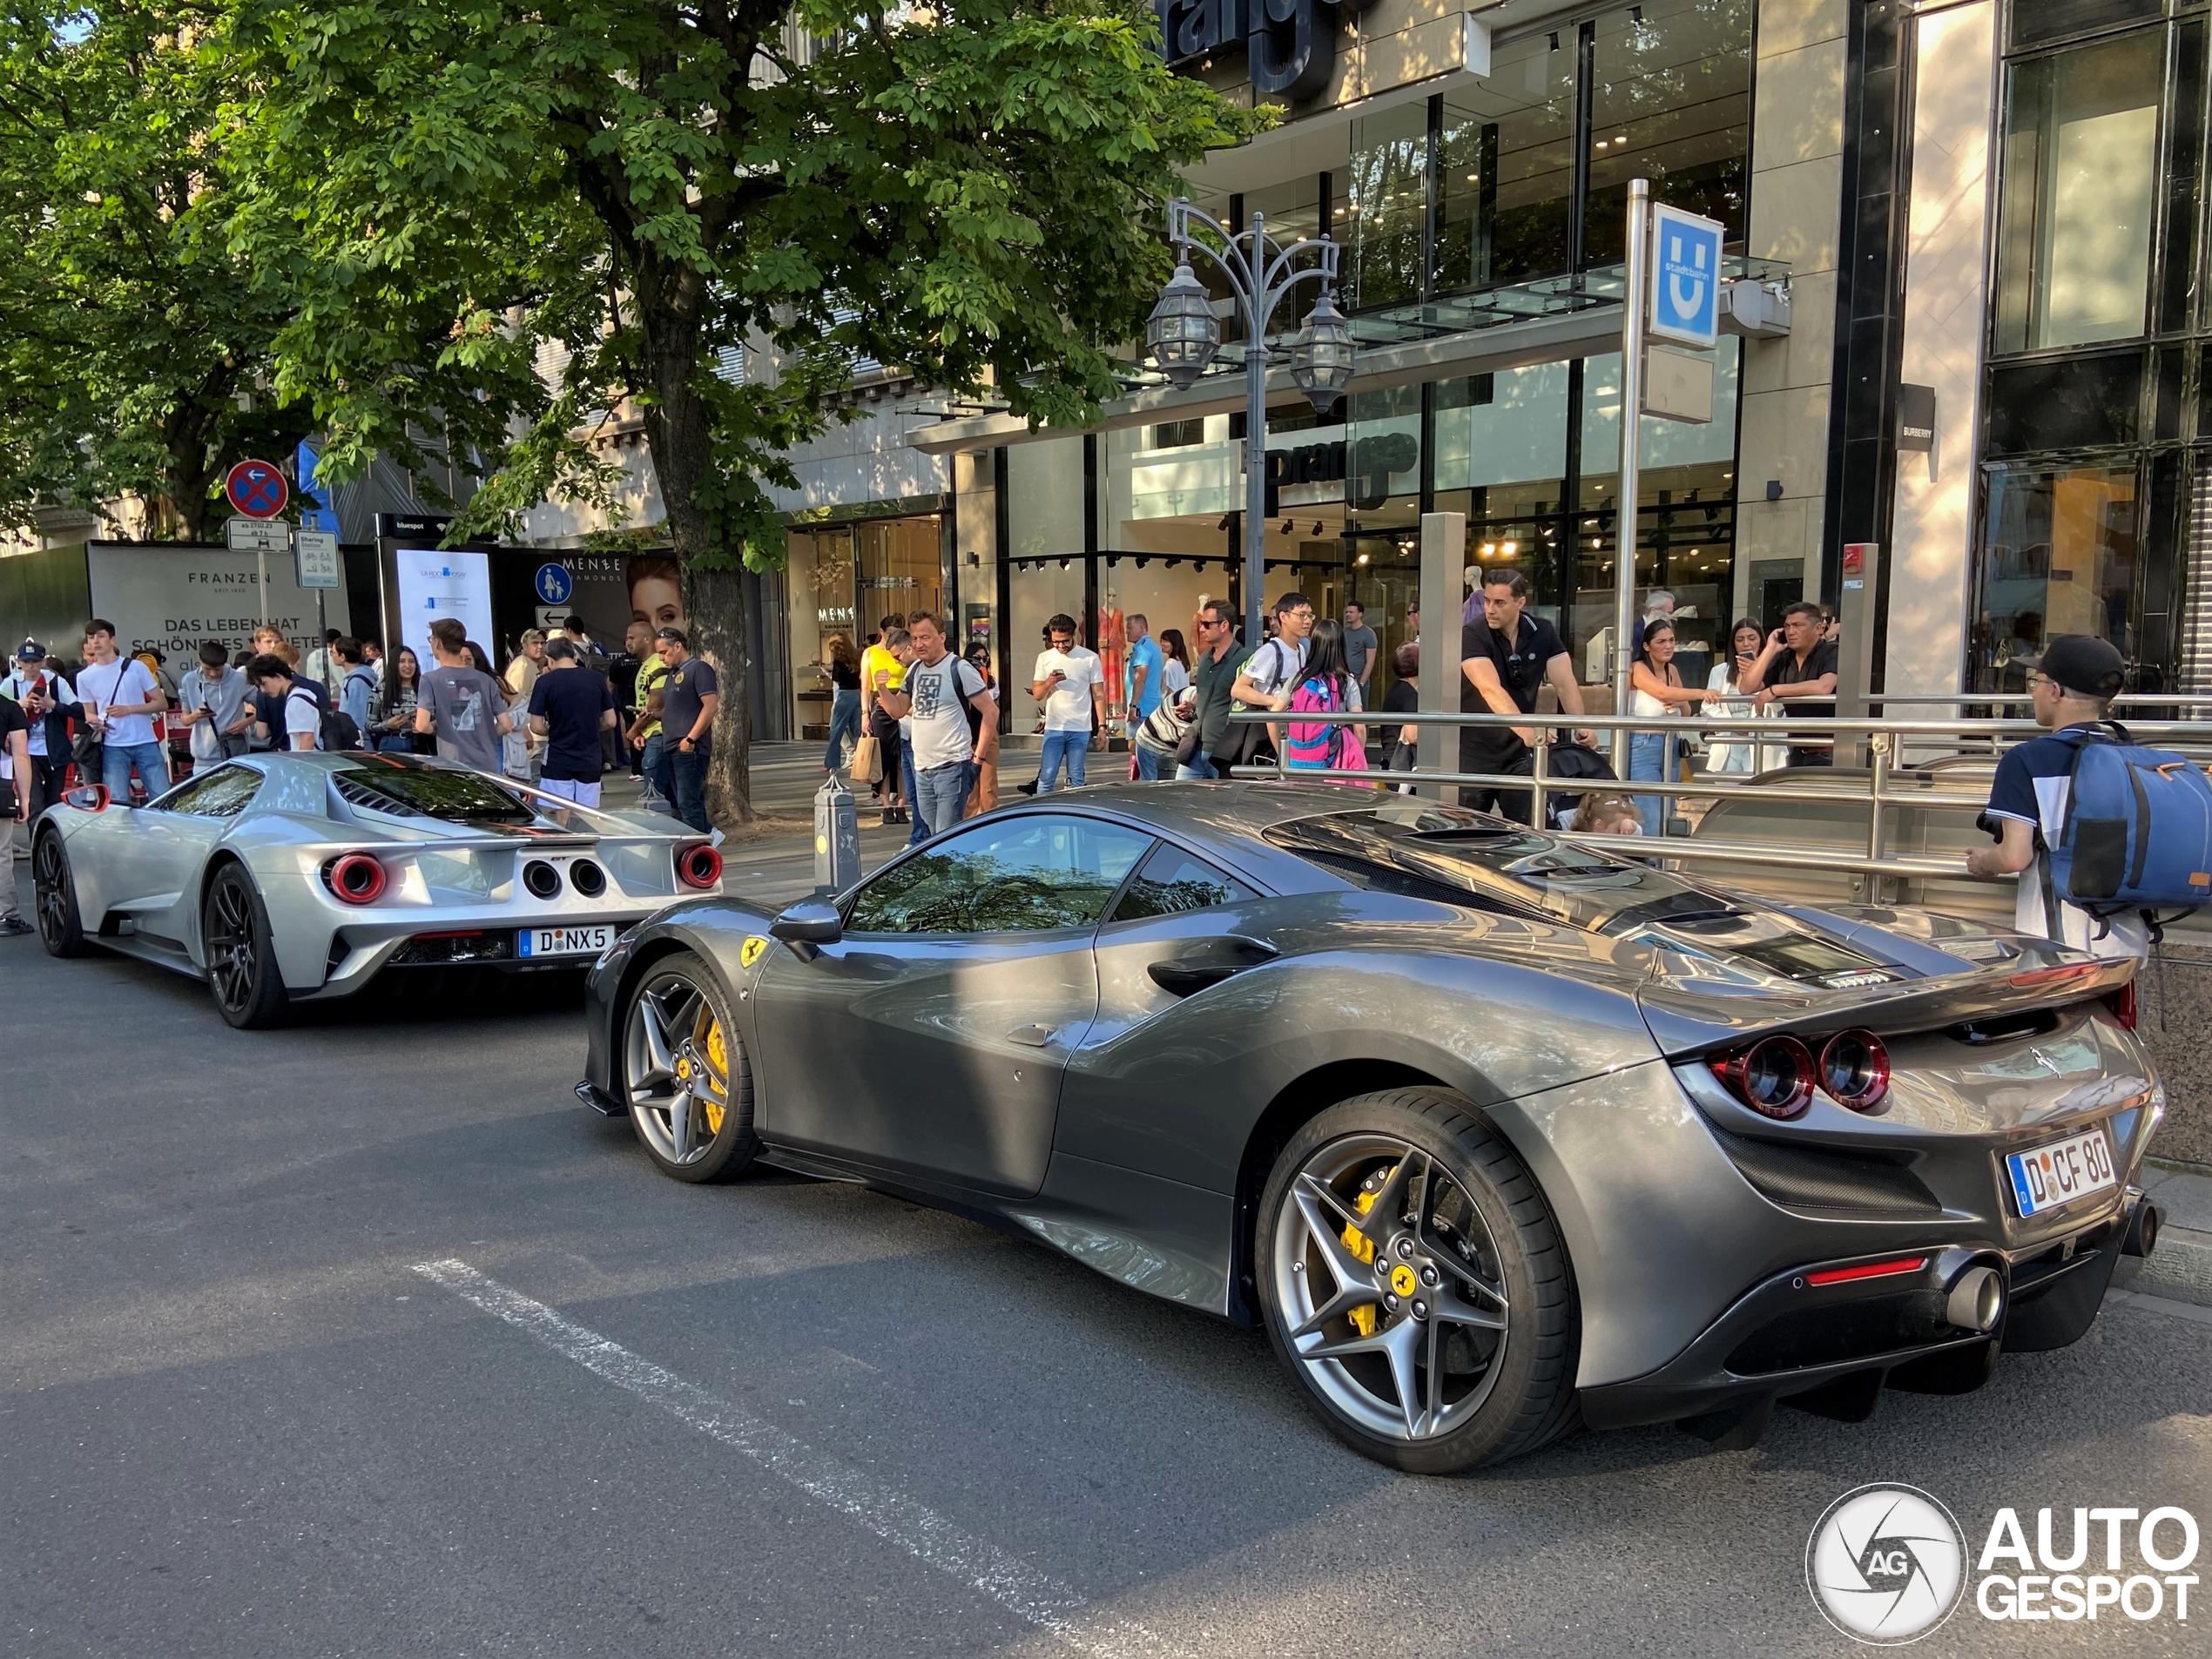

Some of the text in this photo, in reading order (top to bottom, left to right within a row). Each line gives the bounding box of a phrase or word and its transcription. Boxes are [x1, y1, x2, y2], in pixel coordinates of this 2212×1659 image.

[1665, 262, 1710, 281] stadtbahn
[1903, 426, 1932, 439] BURBERRY
[396, 522, 424, 530] bluespot
[188, 572, 271, 583] FRANZEN
[165, 617, 300, 632] DAS LEBEN HAT
[541, 929, 605, 951] D NX 5
[2025, 1137, 2110, 1204] D CF 80
